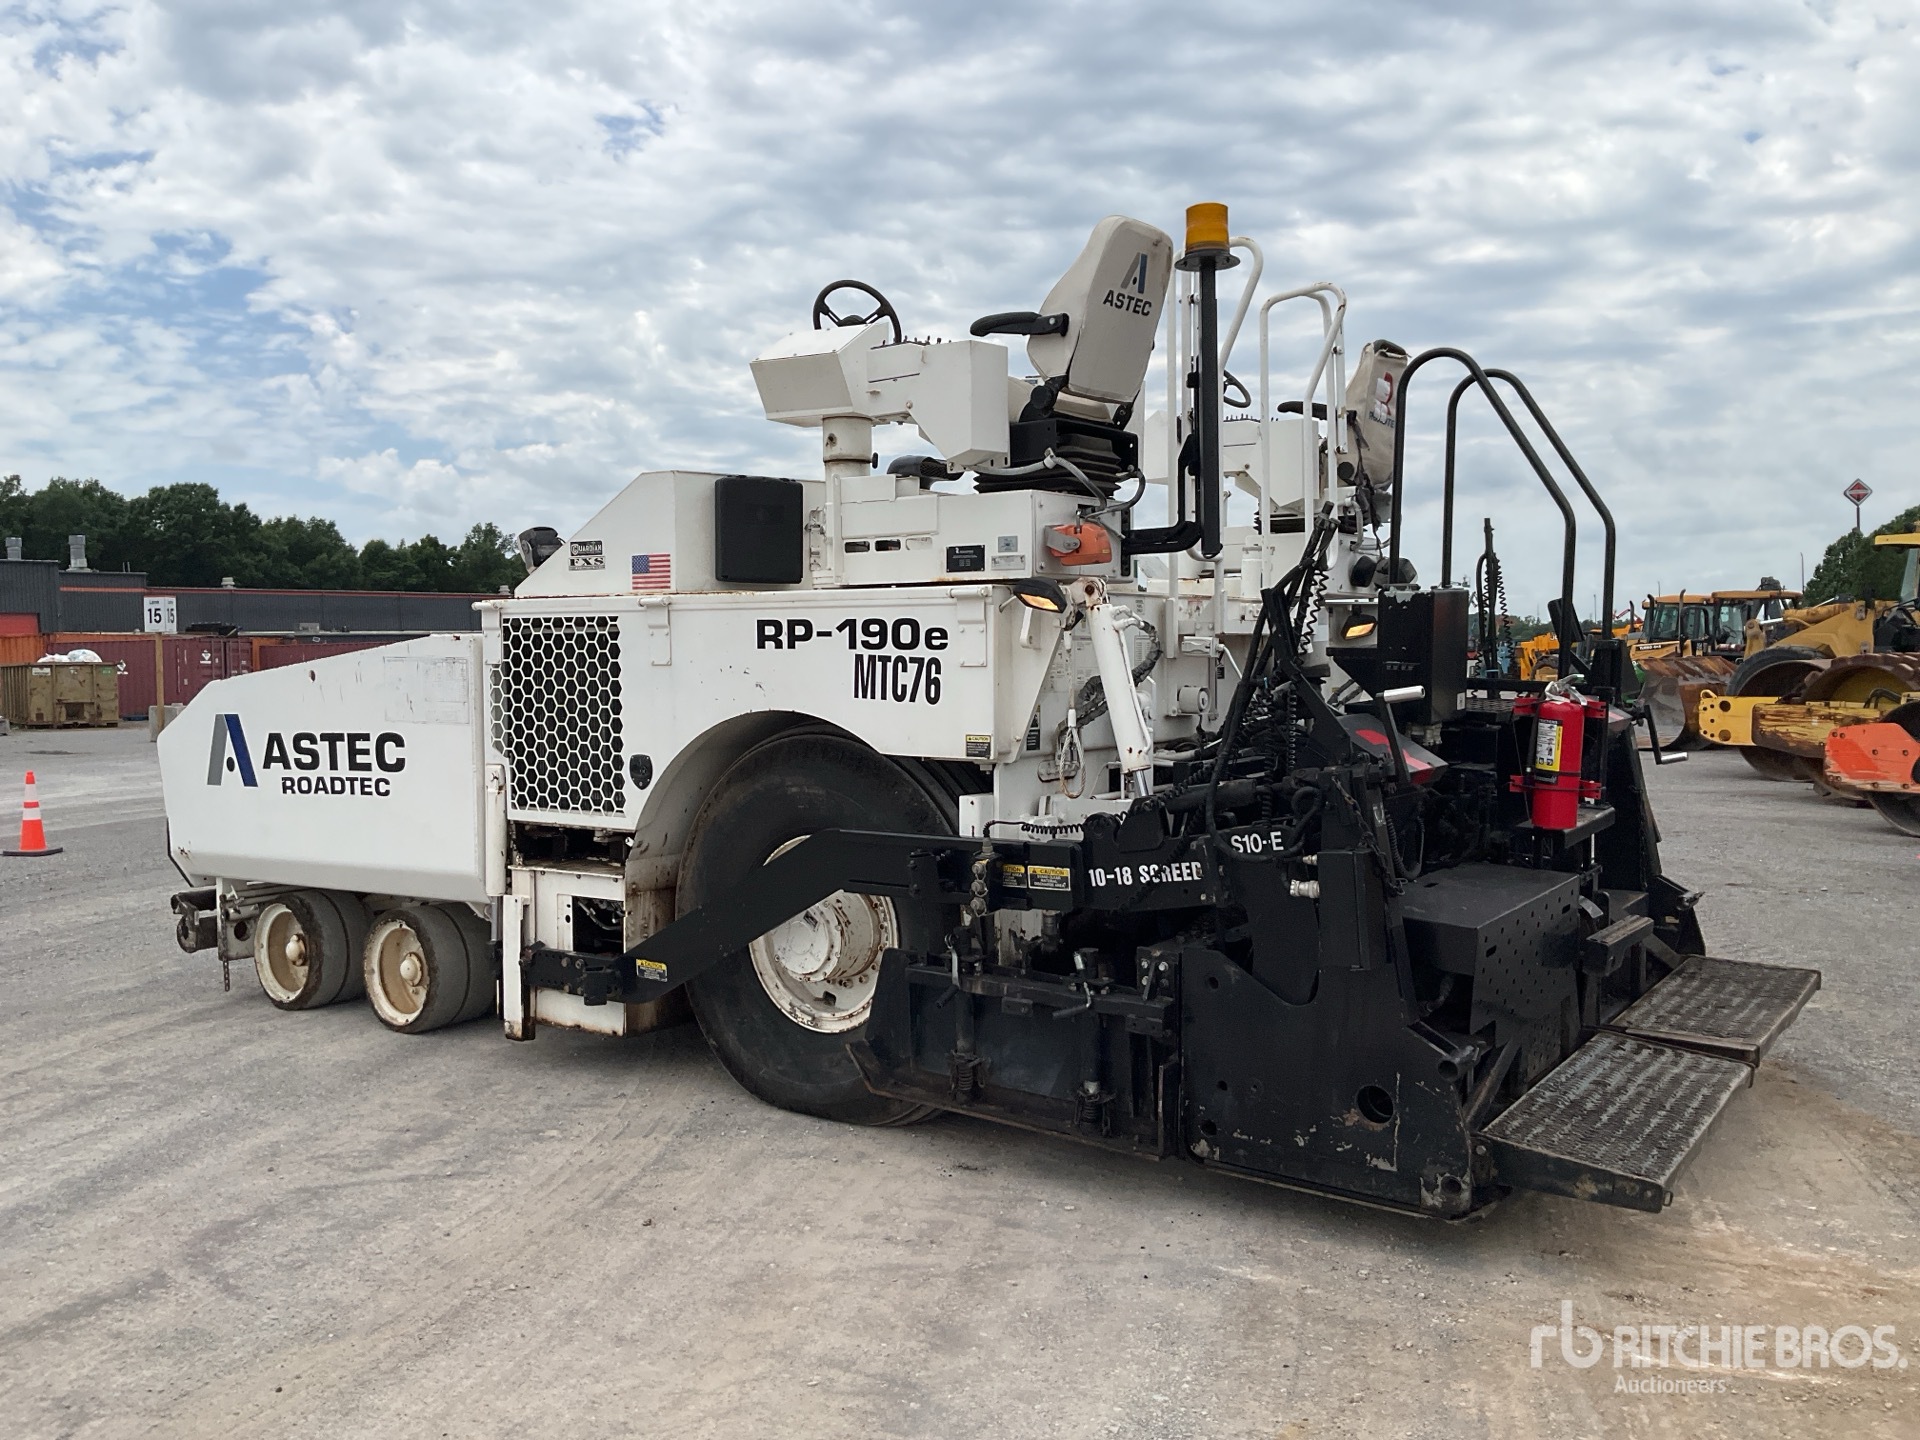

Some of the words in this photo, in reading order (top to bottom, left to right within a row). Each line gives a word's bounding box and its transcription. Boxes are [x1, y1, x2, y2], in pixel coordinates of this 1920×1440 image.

[1103, 289, 1152, 316] ASTEC
[570, 557, 604, 566] FXS
[147, 607, 162, 624] 15
[166, 607, 175, 624] 15
[756, 618, 949, 650] RP-190e
[854, 653, 942, 705] MTC76
[262, 731, 406, 773] ASTEC
[281, 776, 391, 797] ROADTEC
[1230, 831, 1285, 853] S10-E
[1039, 868, 1065, 876] CAUTION
[1088, 866, 1133, 887] 10-18
